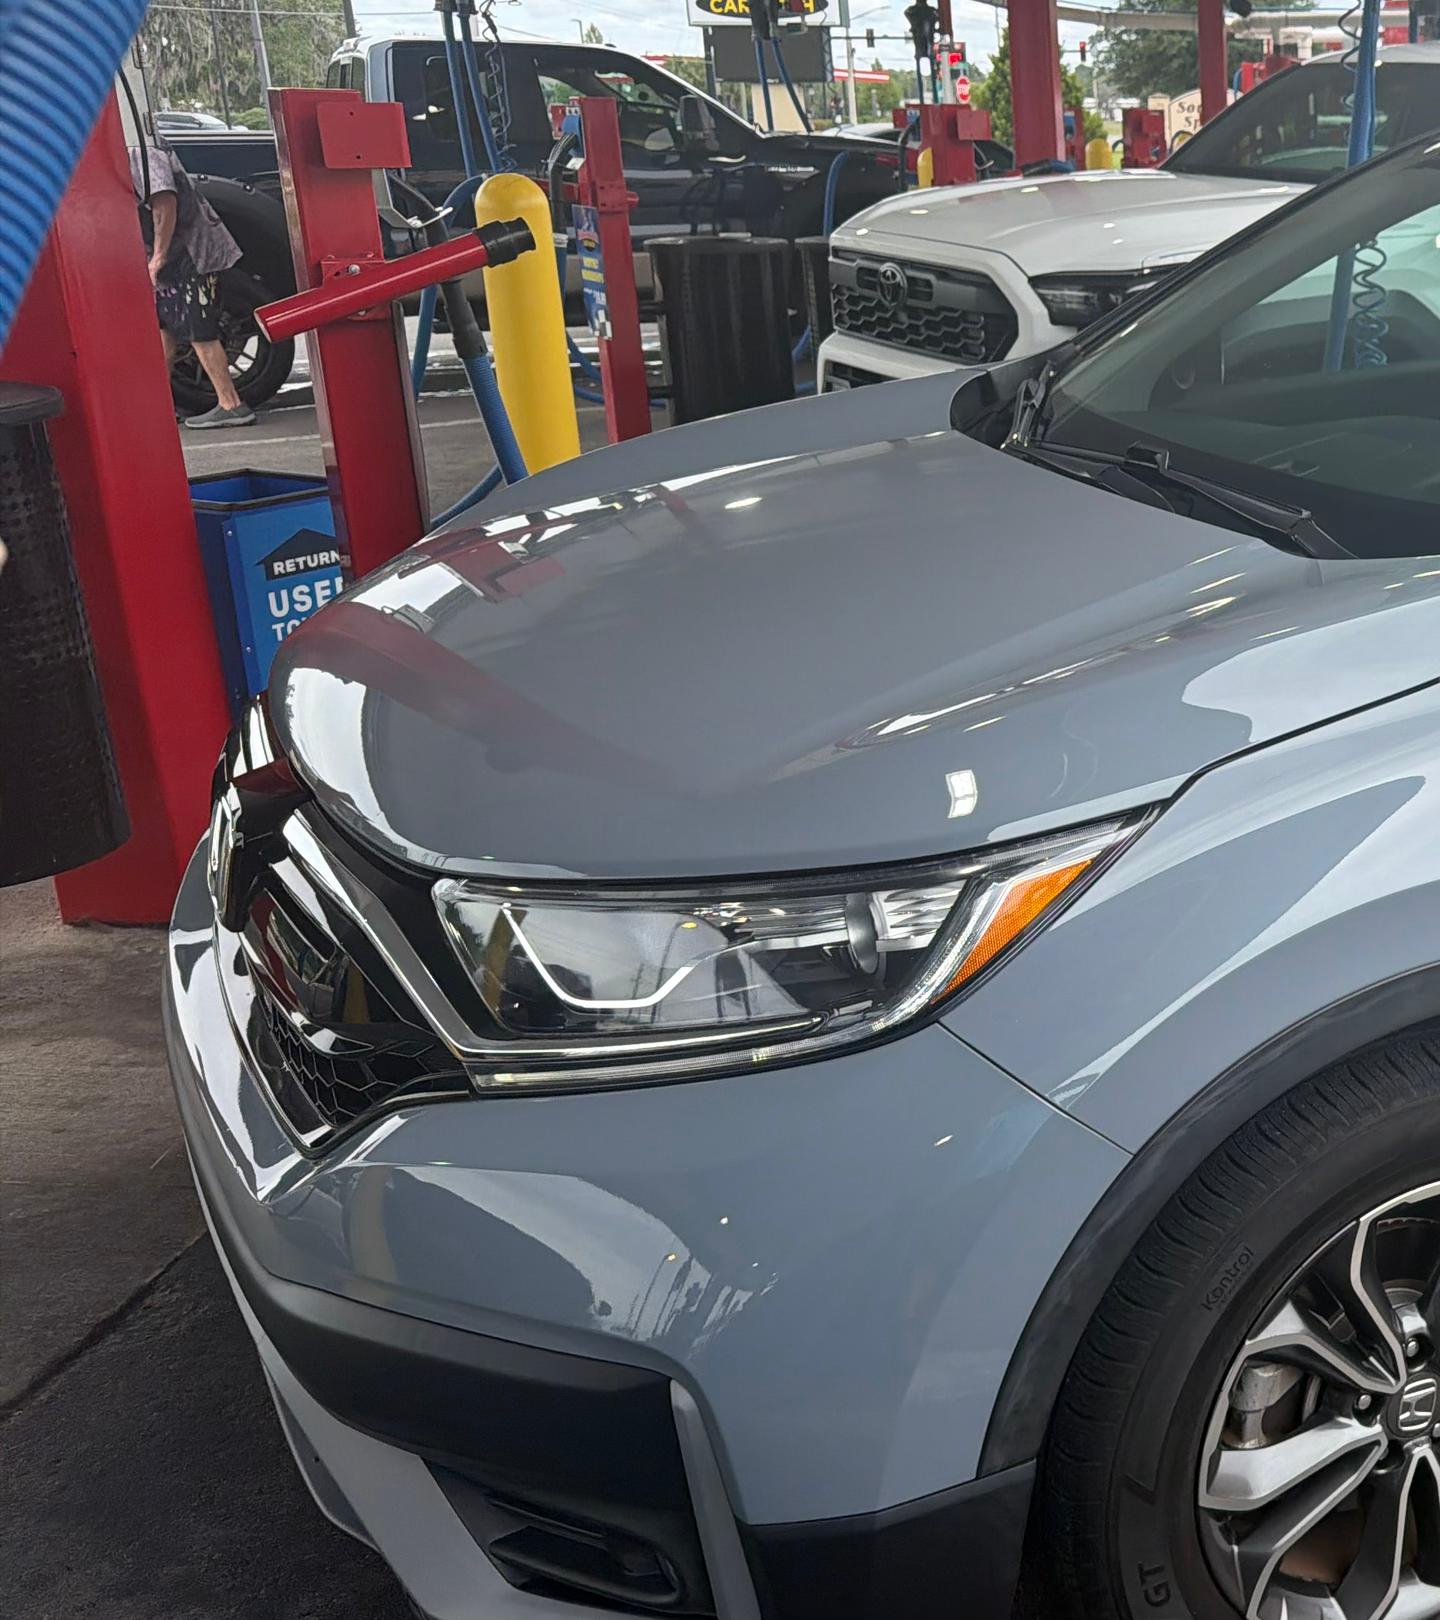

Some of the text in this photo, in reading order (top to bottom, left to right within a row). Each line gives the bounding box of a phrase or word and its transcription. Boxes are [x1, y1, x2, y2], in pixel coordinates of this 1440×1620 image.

[709, 0, 750, 13] CAR
[273, 550, 341, 575] RETURN
[1201, 1245, 1254, 1311] Kontrol
[1138, 1562, 1170, 1608] GT
